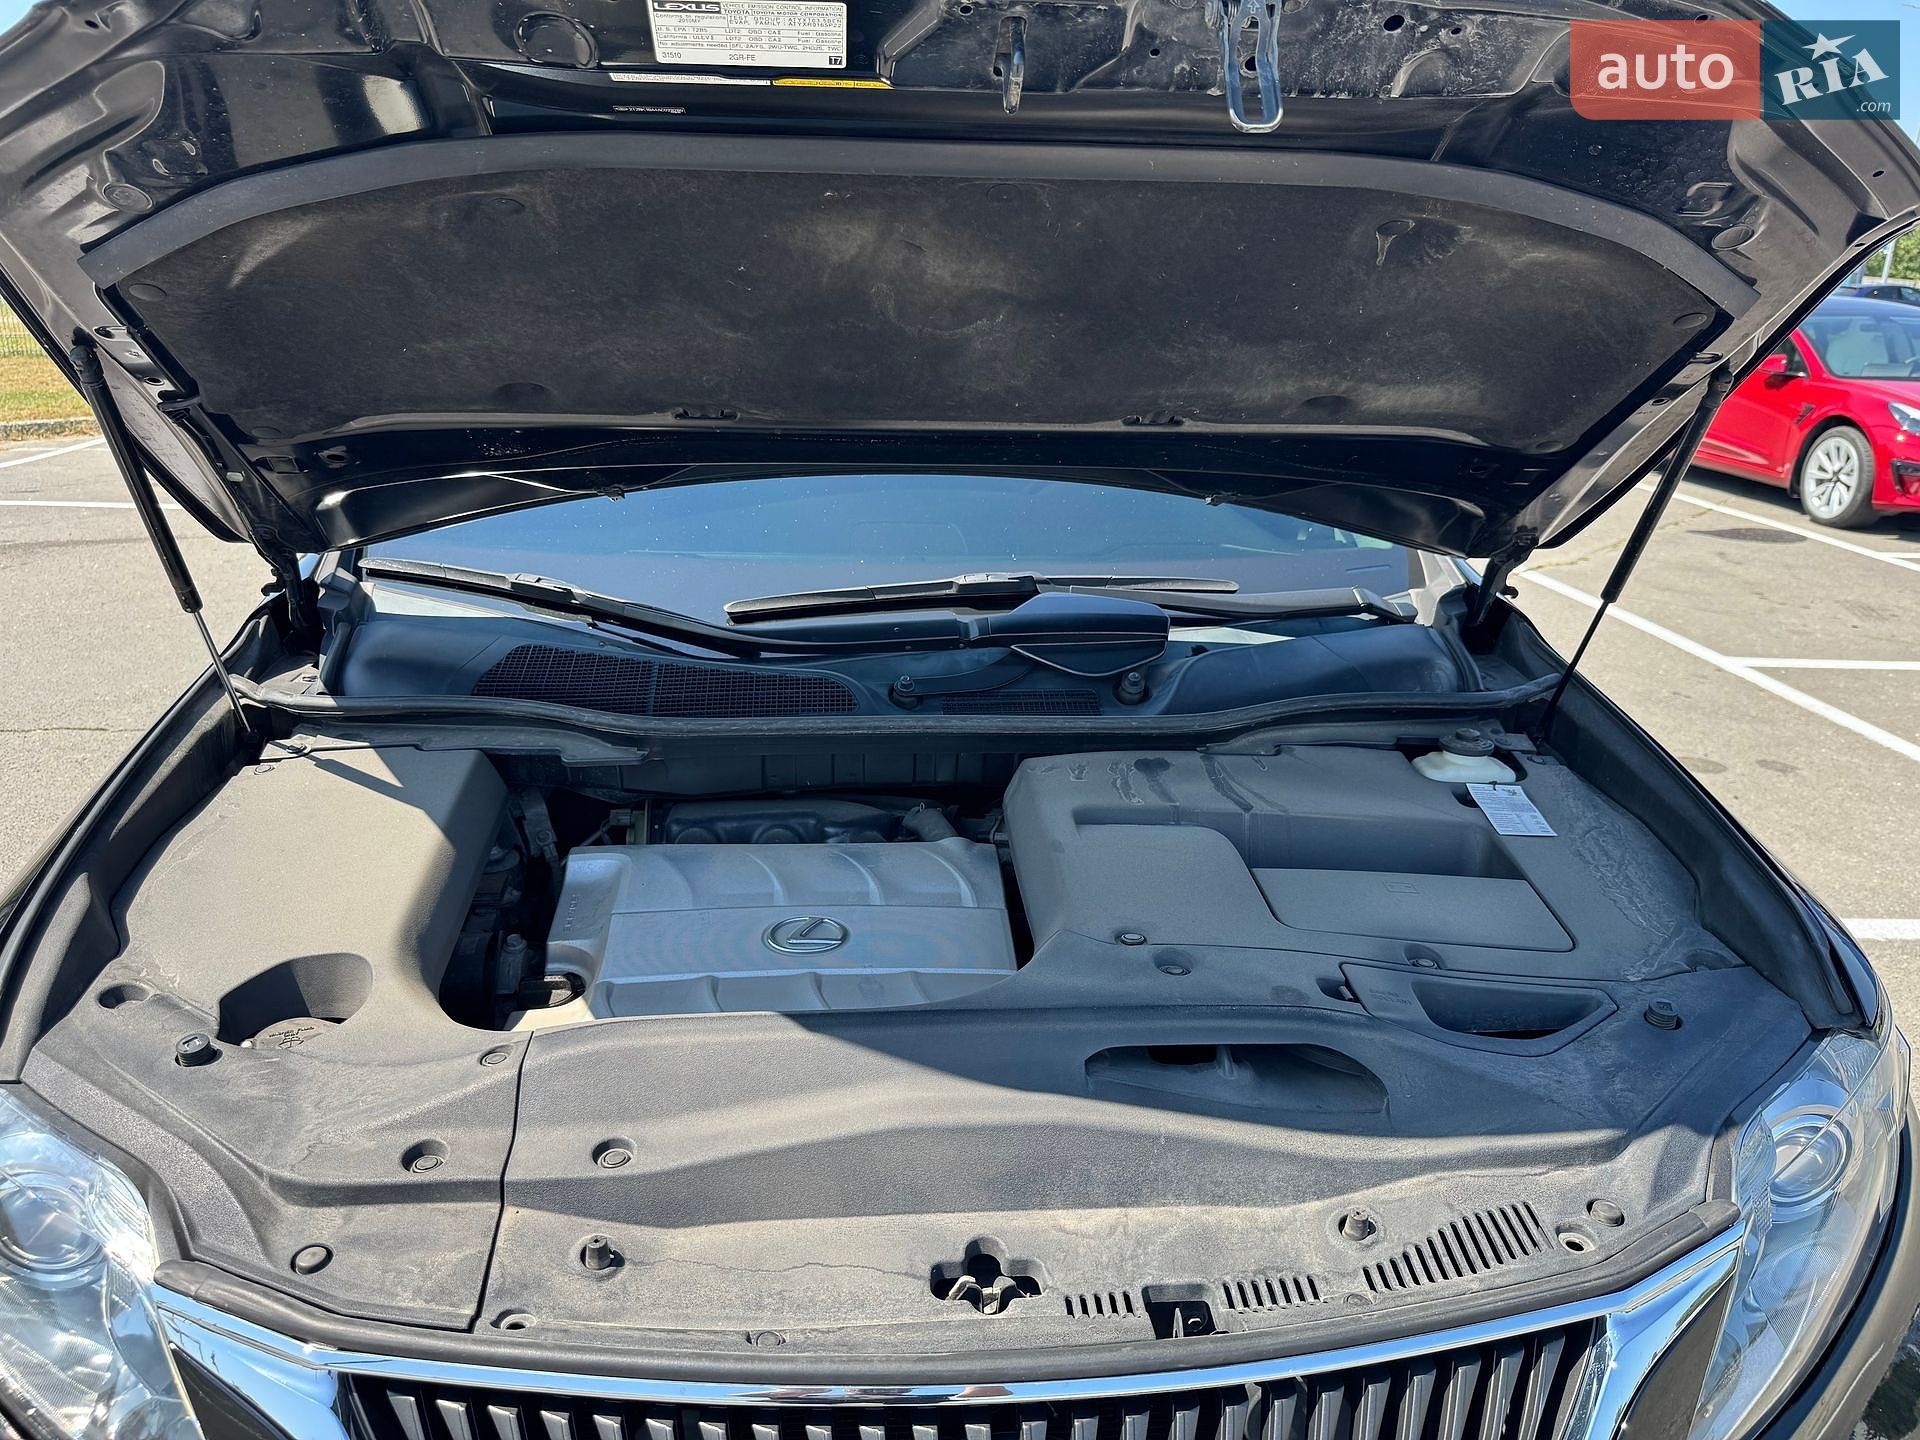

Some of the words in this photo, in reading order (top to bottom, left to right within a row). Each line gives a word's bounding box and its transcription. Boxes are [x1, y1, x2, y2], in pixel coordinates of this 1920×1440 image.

[653, 2, 720, 11] LEXUS
[661, 51, 682, 59] 31510
[728, 53, 757, 61] 2GR-FE
[830, 56, 842, 65] T7
